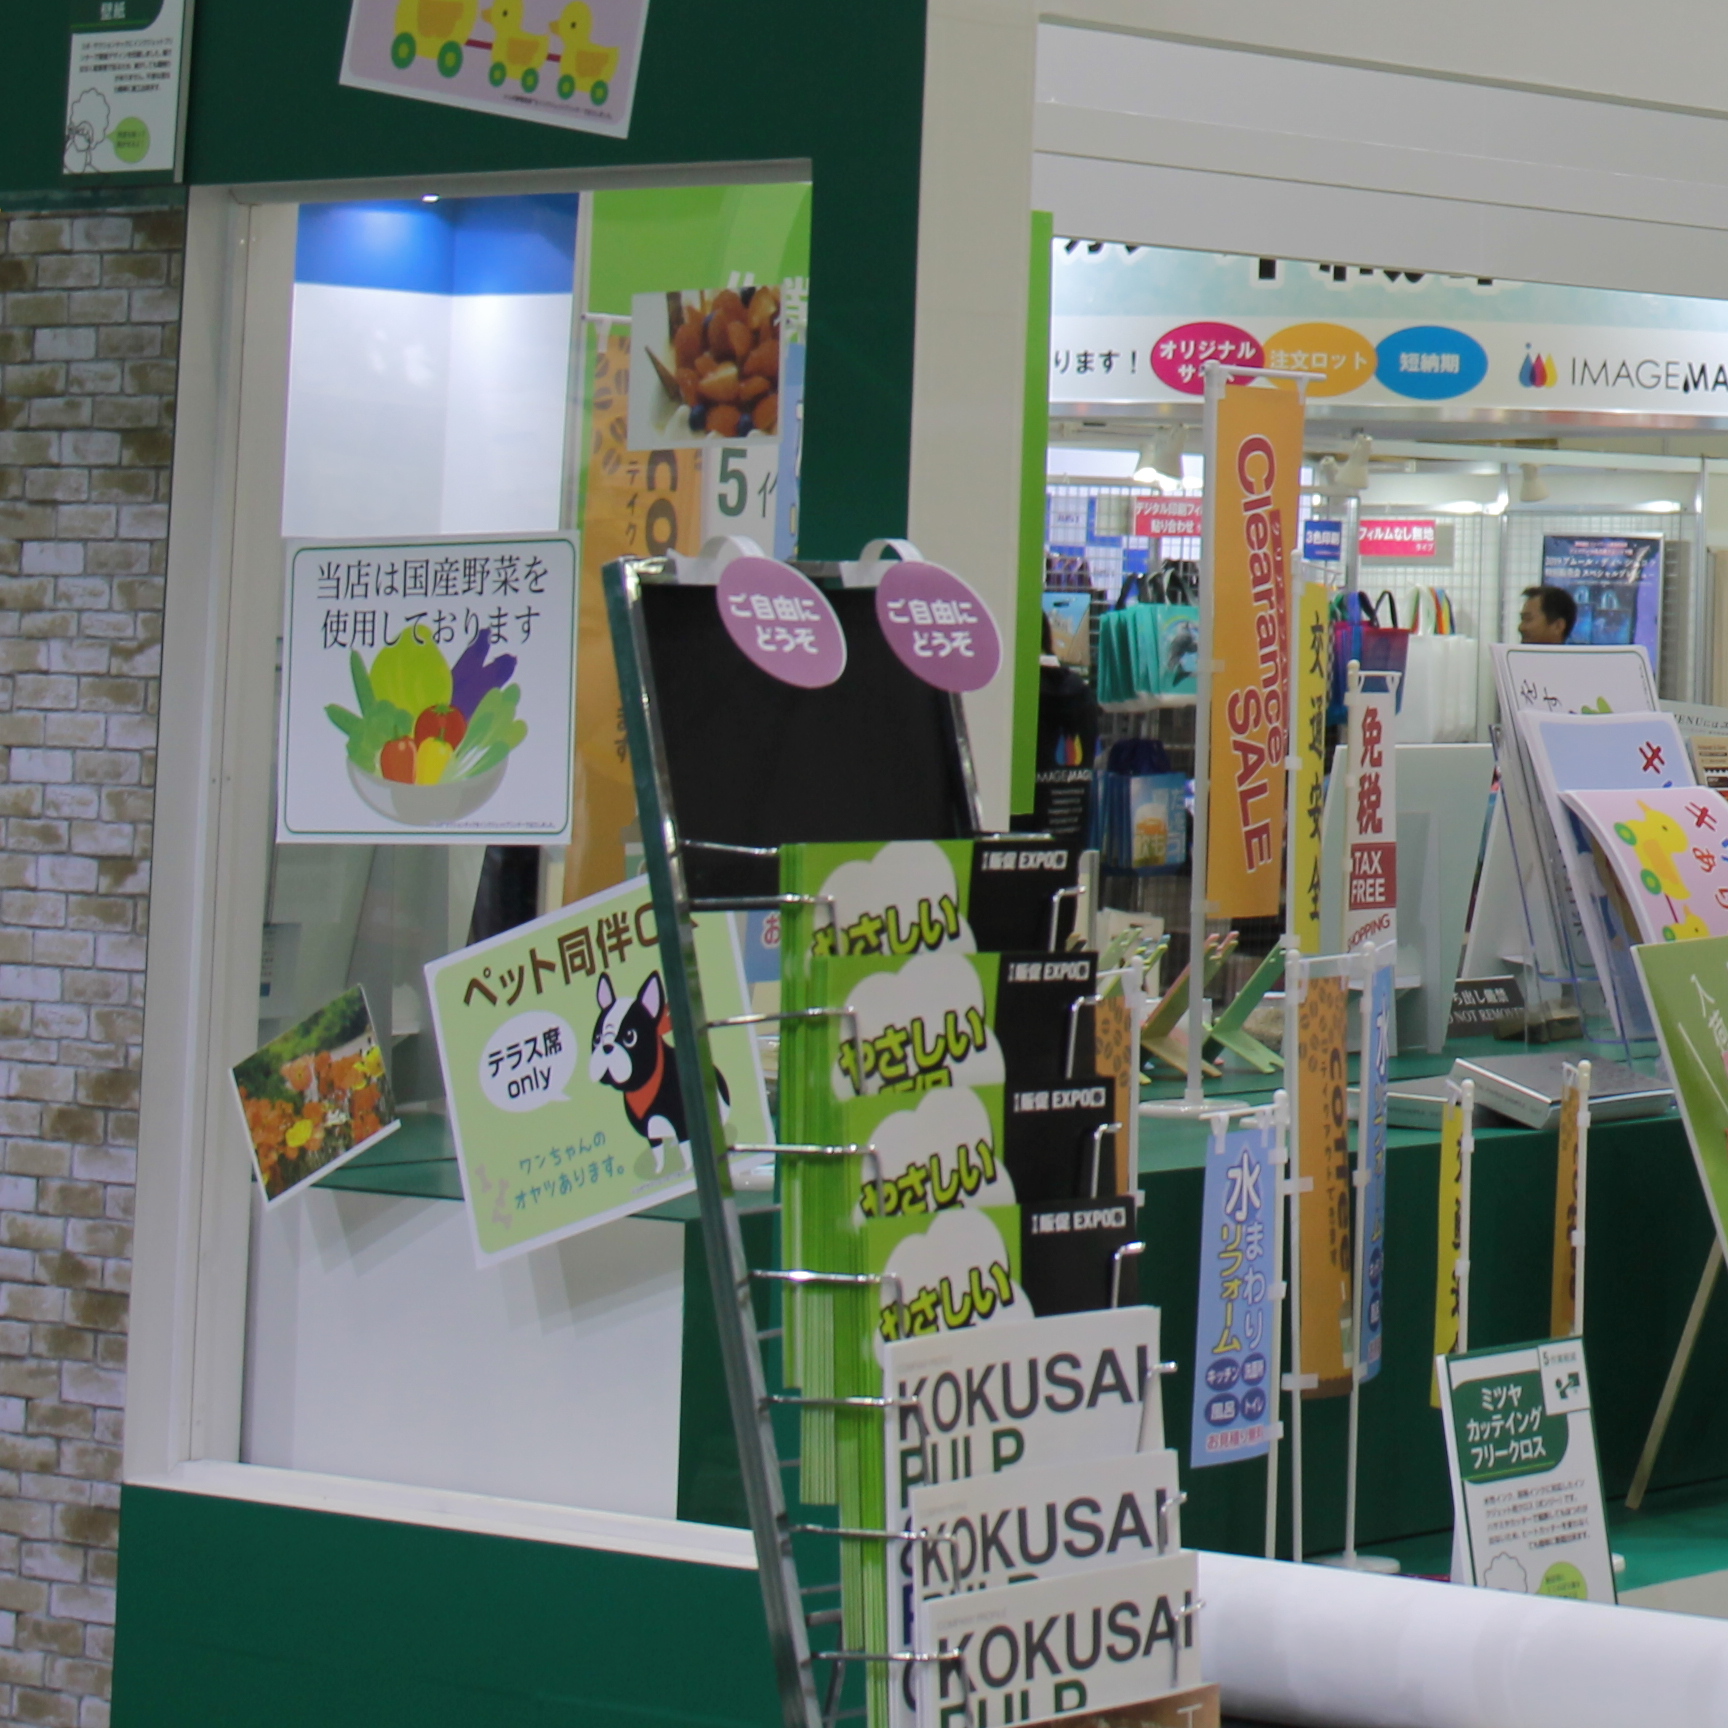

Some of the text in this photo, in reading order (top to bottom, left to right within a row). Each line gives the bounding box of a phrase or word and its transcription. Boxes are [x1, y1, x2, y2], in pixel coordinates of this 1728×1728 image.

[1158, 339, 1256, 361] オリジナル
[1270, 349, 1368, 371] 注文ロット
[1399, 350, 1460, 376] 短納期
[1304, 528, 1340, 545] 3色印刷
[317, 555, 548, 600] 当店は国産野菜を
[1236, 433, 1283, 767] Clearance
[322, 605, 541, 650] 使用しております
[729, 593, 821, 622] ご自由に
[887, 599, 978, 625] ご自由に
[756, 625, 818, 654] どうぞ
[913, 630, 975, 658] どうぞ
[1226, 684, 1273, 873] SALE
[1355, 704, 1384, 836] 免税
[1354, 849, 1383, 875] TAX
[1352, 877, 1386, 904] FREE
[811, 893, 960, 957] やさしい
[488, 1025, 564, 1079] テラス席
[839, 1005, 987, 1080] やさしい
[506, 1065, 553, 1100] only
[518, 1130, 607, 1176] ワンちゃんの
[515, 1154, 626, 1210] オヤツあります。
[861, 1138, 996, 1217] やさしい
[880, 1260, 1015, 1341] やさしい
[1211, 1222, 1245, 1356] リフォーム
[899, 1344, 1150, 1441] KOKUSAI
[1481, 1383, 1523, 1411] ミツヤ
[1470, 1435, 1547, 1470] フリークロス
[921, 1487, 1169, 1588] KOKUSAI
[938, 1589, 1194, 1700] KOKUSAI
